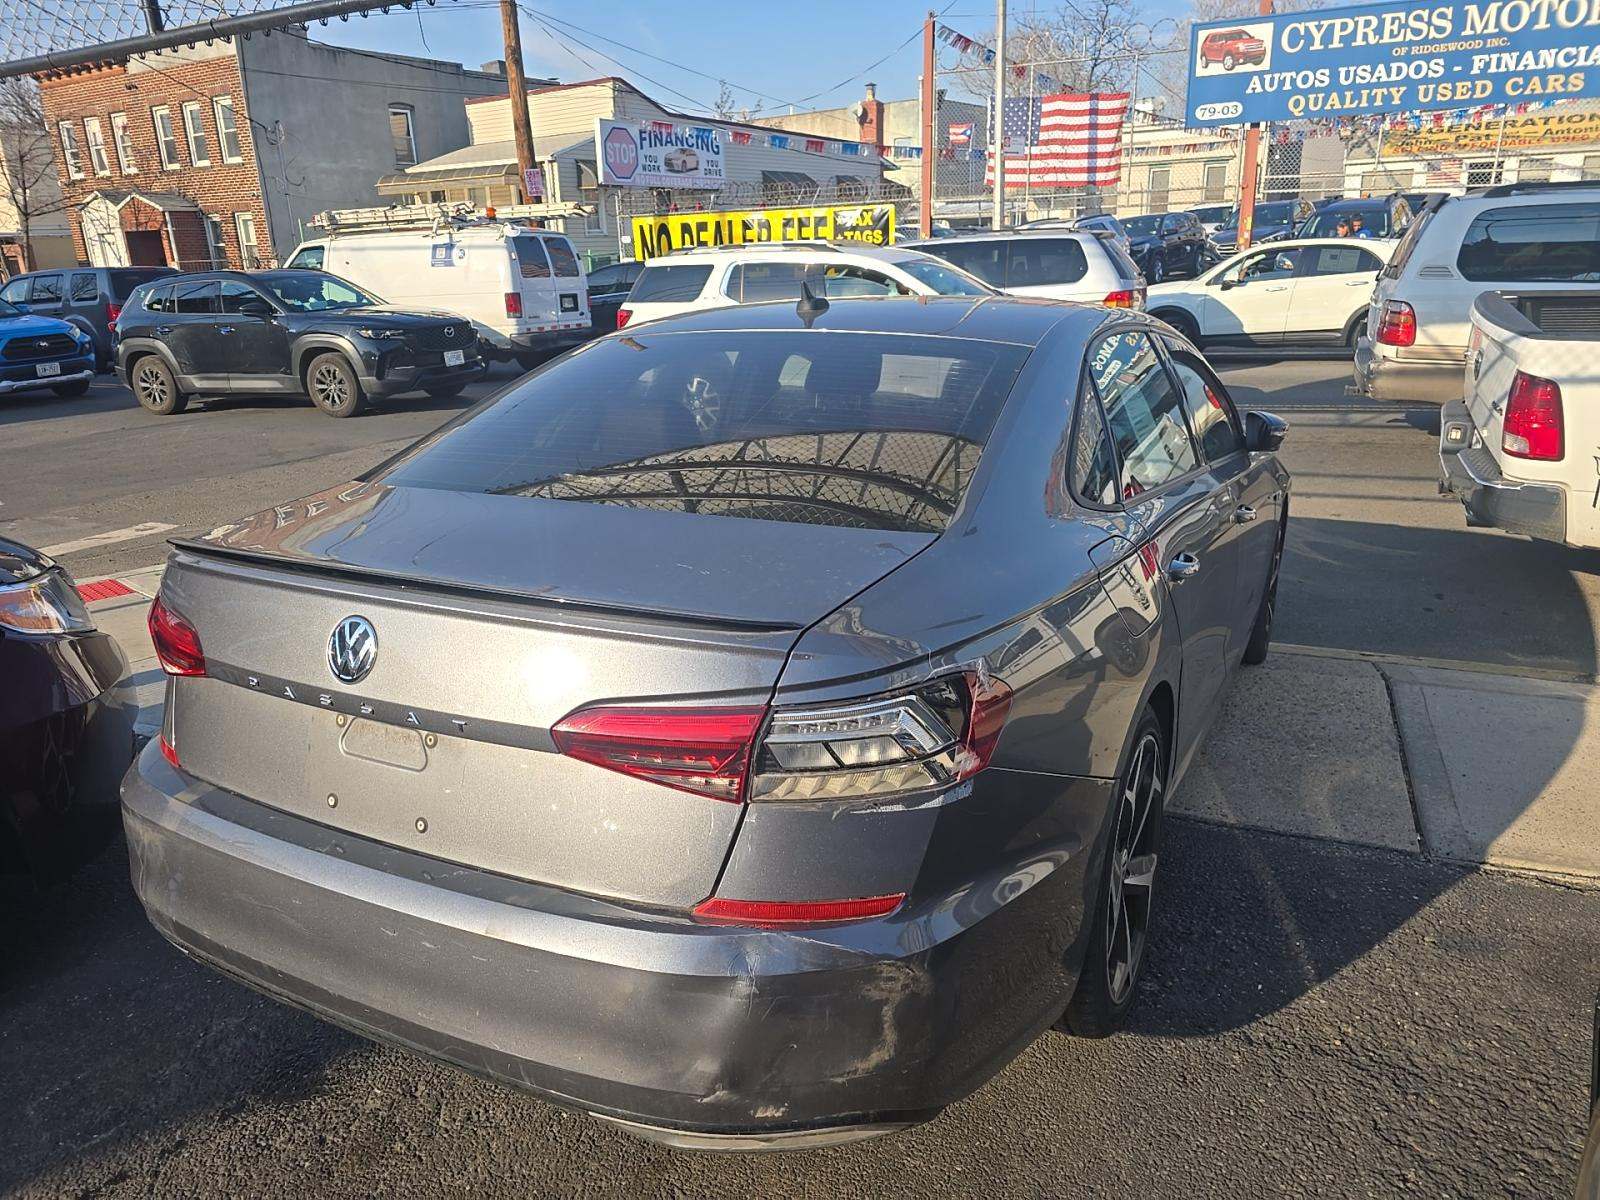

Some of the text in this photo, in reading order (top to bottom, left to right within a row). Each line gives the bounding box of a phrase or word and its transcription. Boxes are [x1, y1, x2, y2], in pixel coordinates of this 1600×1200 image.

[1281, 7, 1453, 53] CYPRESS
[1392, 37, 1511, 57] OF RIDGEWOOD INC.
[1245, 66, 1330, 94] AUTOS
[1338, 58, 1444, 85] USADOS
[1288, 72, 1585, 116] QUALITY USED CARS
[1200, 105, 1239, 118] 79-03
[607, 142, 637, 165] STOP
[640, 128, 720, 156] FINANCING
[641, 164, 662, 173] WORK
[644, 154, 658, 164] YOU
[706, 160, 719, 168] YOU
[703, 168, 722, 177] DRIVE
[639, 222, 673, 260] NO
[248, 675, 468, 733] PASSAT
